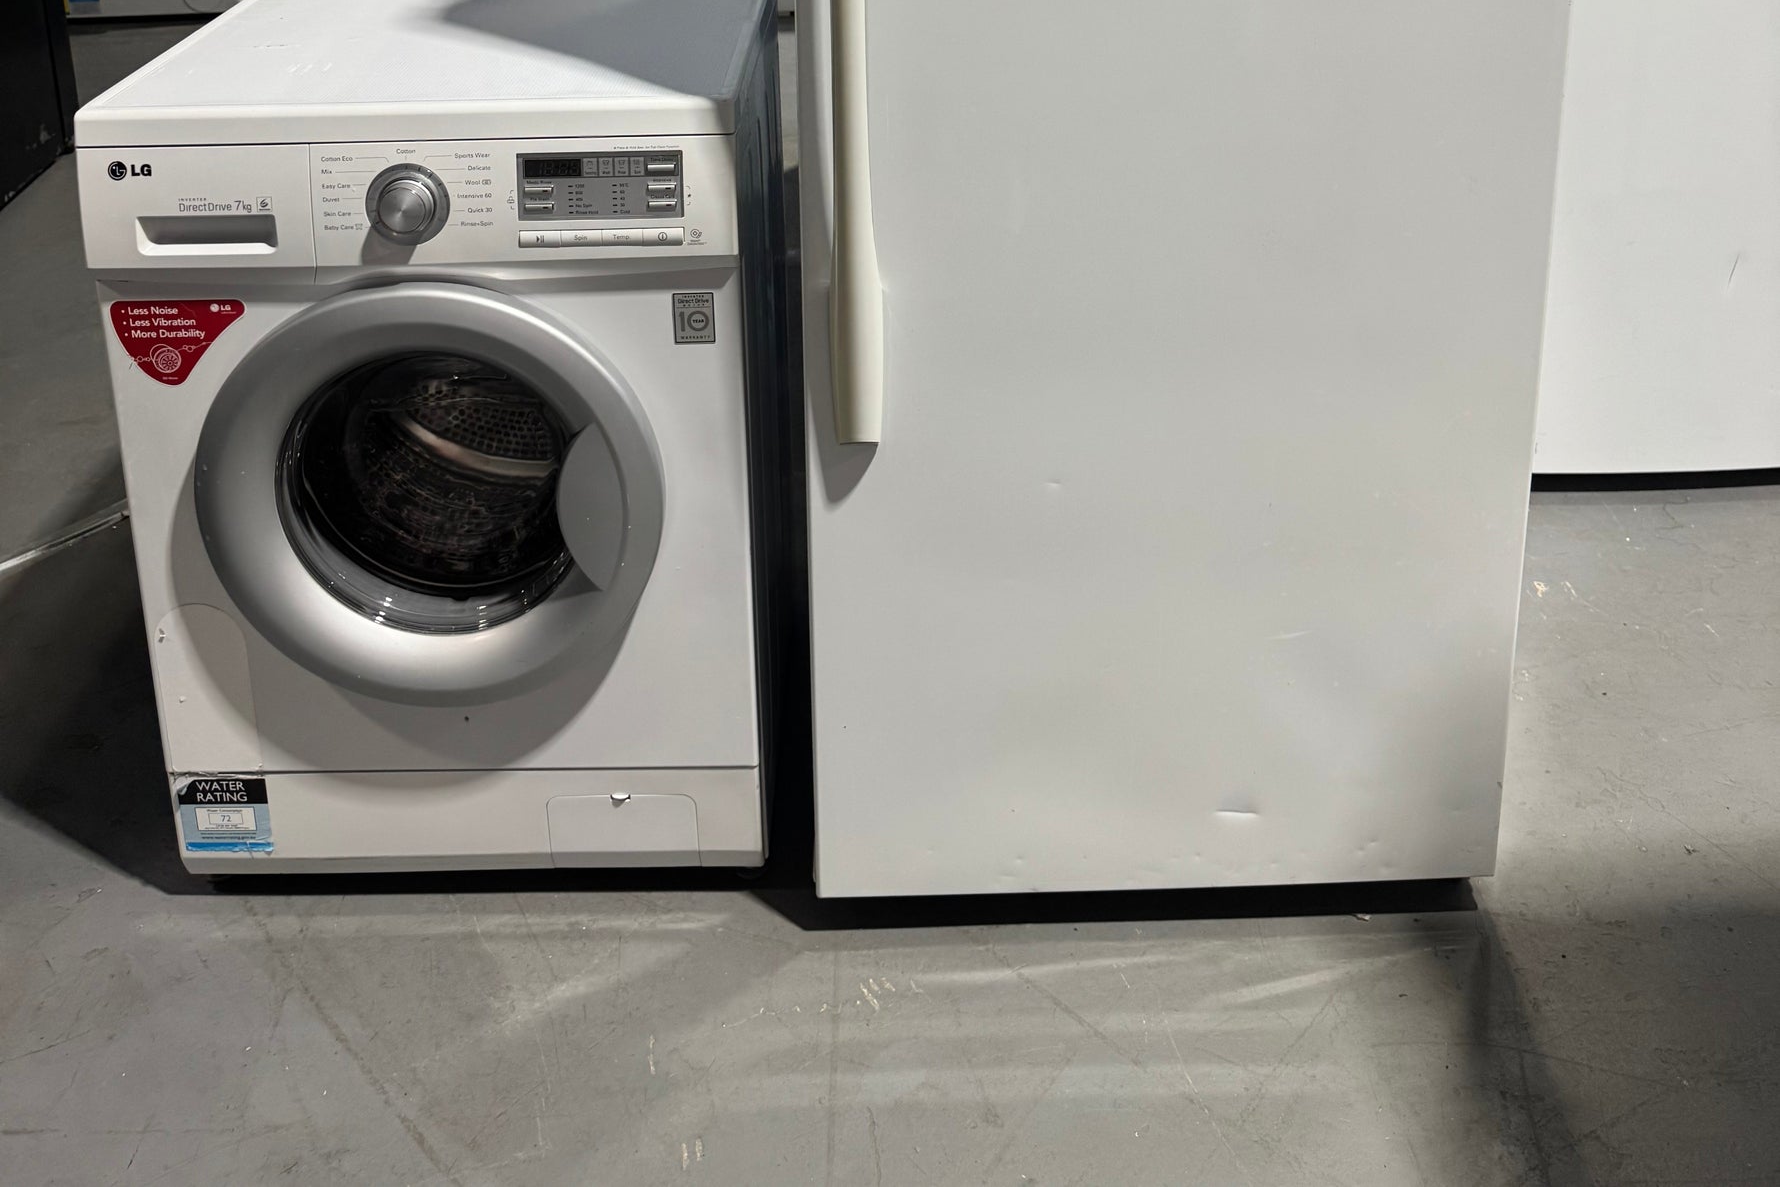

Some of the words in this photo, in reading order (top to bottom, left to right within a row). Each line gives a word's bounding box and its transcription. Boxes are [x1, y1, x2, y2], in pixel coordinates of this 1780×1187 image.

[131, 164, 152, 176] LG
[234, 200, 252, 213] 7kg
[128, 307, 149, 315] Less
[151, 306, 178, 314] Noise
[129, 318, 150, 326] Less
[151, 317, 196, 326] Vibration
[679, 310, 710, 332] 10
[131, 330, 157, 338] More
[159, 329, 205, 339] Durability
[195, 781, 245, 791] WATER
[196, 792, 248, 802] RATING
